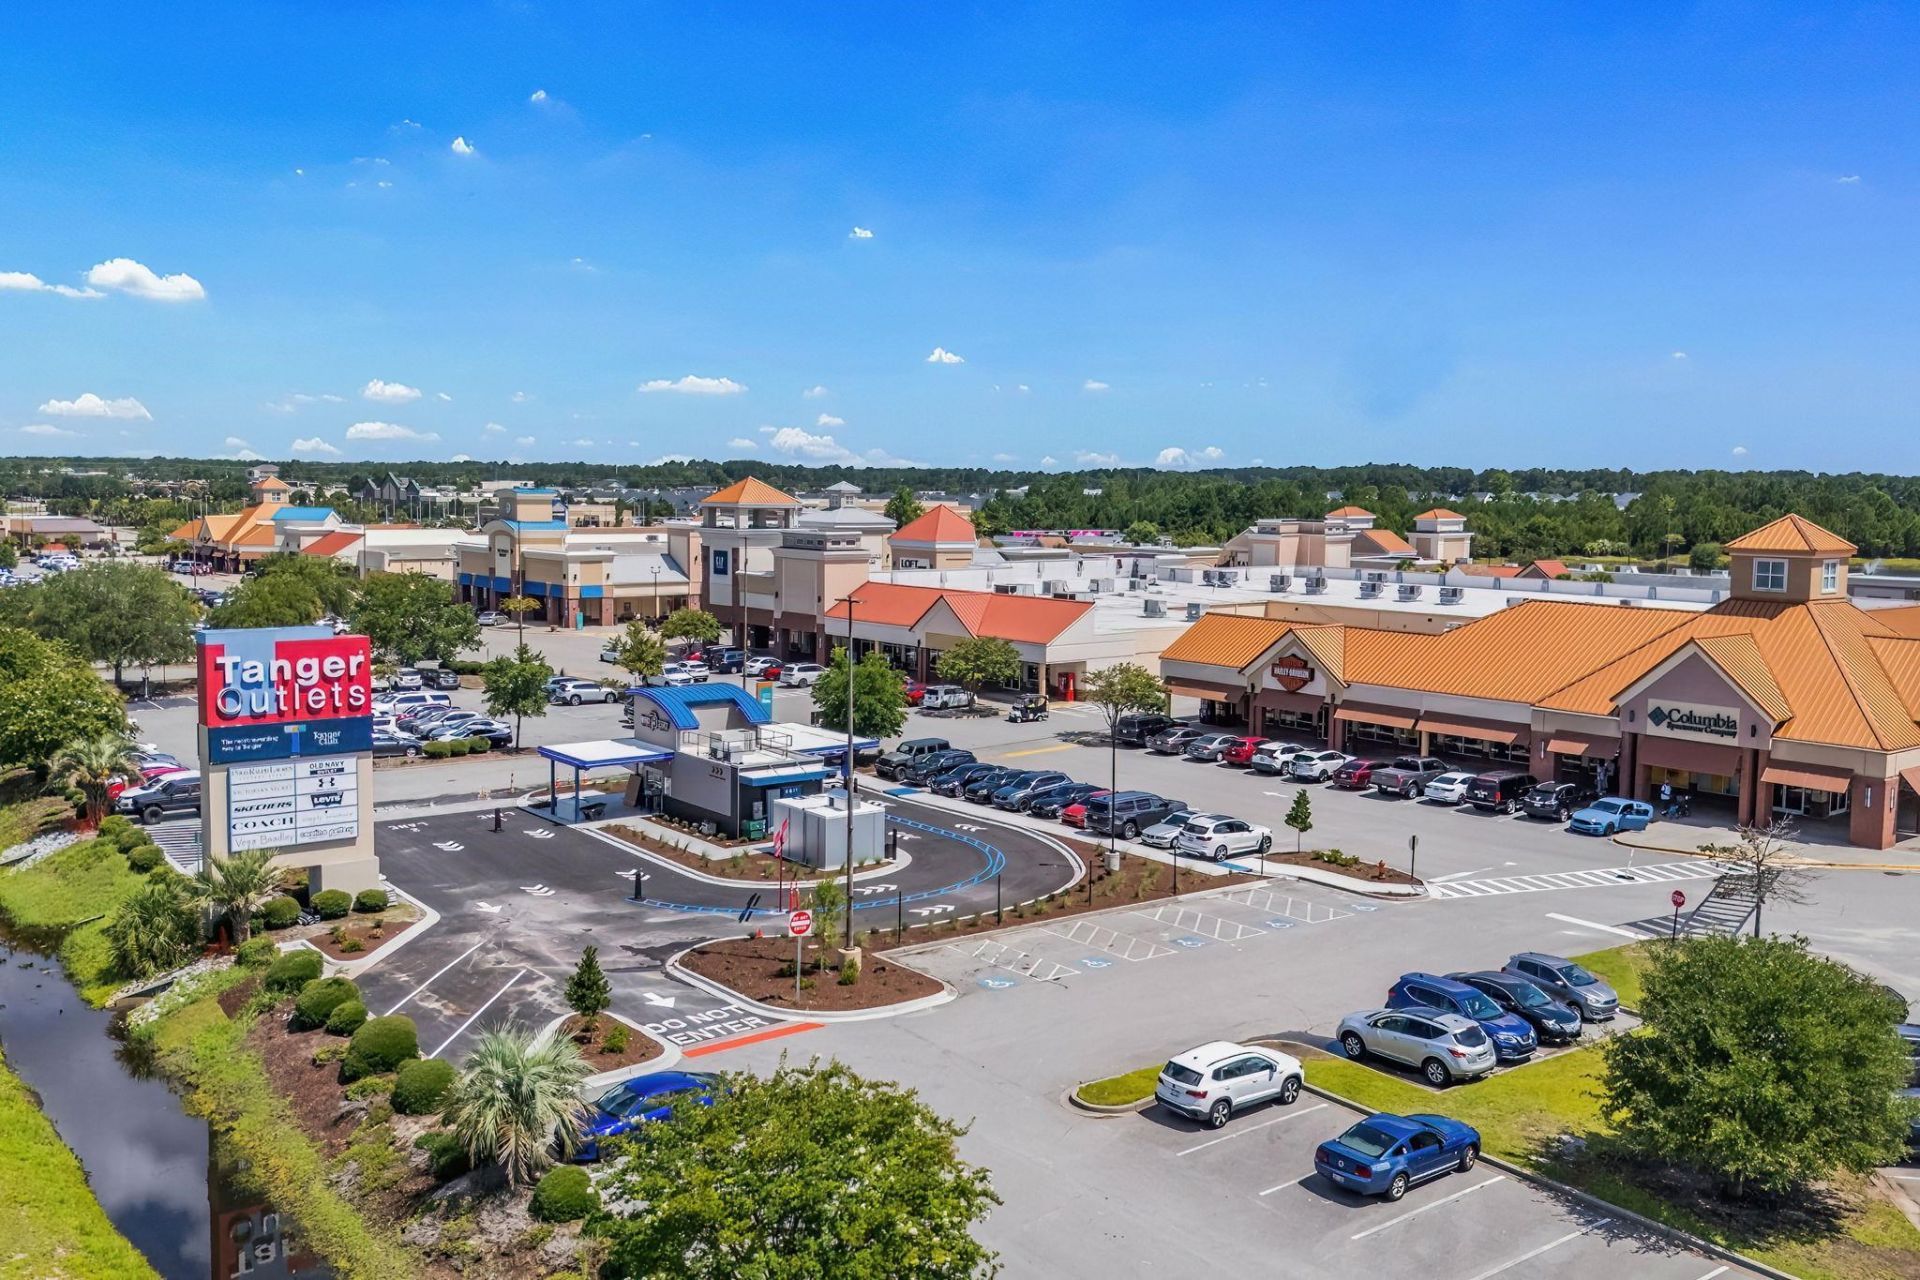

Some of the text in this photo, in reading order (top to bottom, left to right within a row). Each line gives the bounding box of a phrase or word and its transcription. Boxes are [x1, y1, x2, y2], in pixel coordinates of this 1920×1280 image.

[900, 559, 918, 568] LOFT
[216, 655, 365, 687] Tanger
[216, 682, 366, 715] Outlets
[1667, 708, 1738, 730] Columbia
[309, 760, 345, 770] OLD NAVY
[234, 801, 292, 813] SKECHERS
[232, 816, 294, 831] COACH
[643, 1003, 745, 1034] DO NOT
[666, 1015, 770, 1046] ENTER
